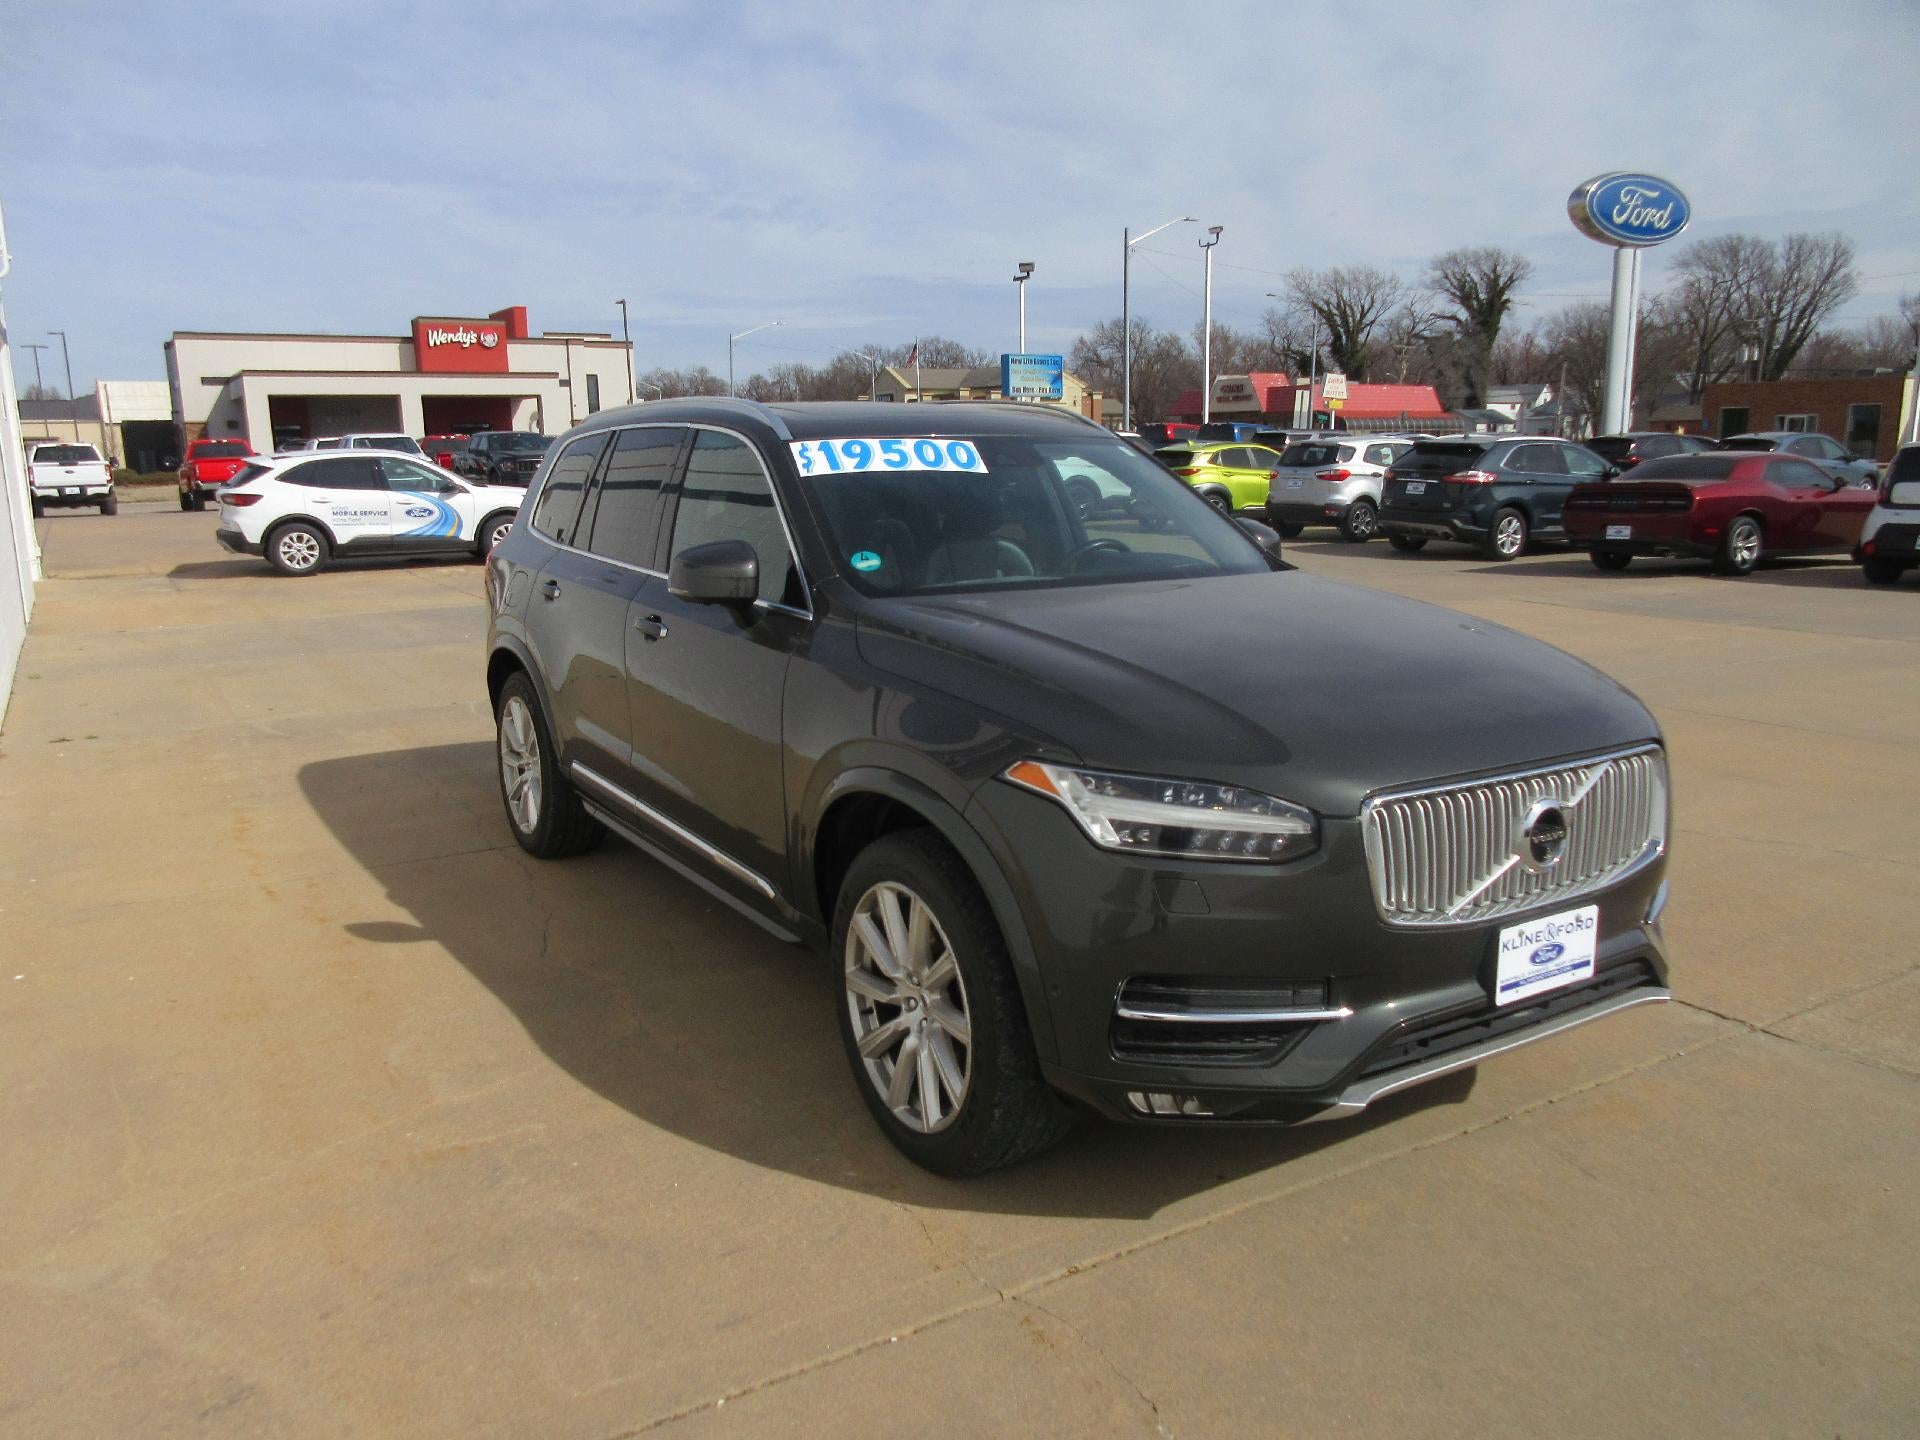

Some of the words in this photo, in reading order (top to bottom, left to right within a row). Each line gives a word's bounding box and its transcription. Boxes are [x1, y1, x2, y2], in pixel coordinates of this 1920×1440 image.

[1612, 186, 1673, 230] Ford
[428, 326, 478, 348] Wendy's
[799, 439, 978, 473] $19500
[410, 507, 431, 518] Ford
[1502, 930, 1543, 953] KLINE
[1557, 917, 1594, 937] FORD
